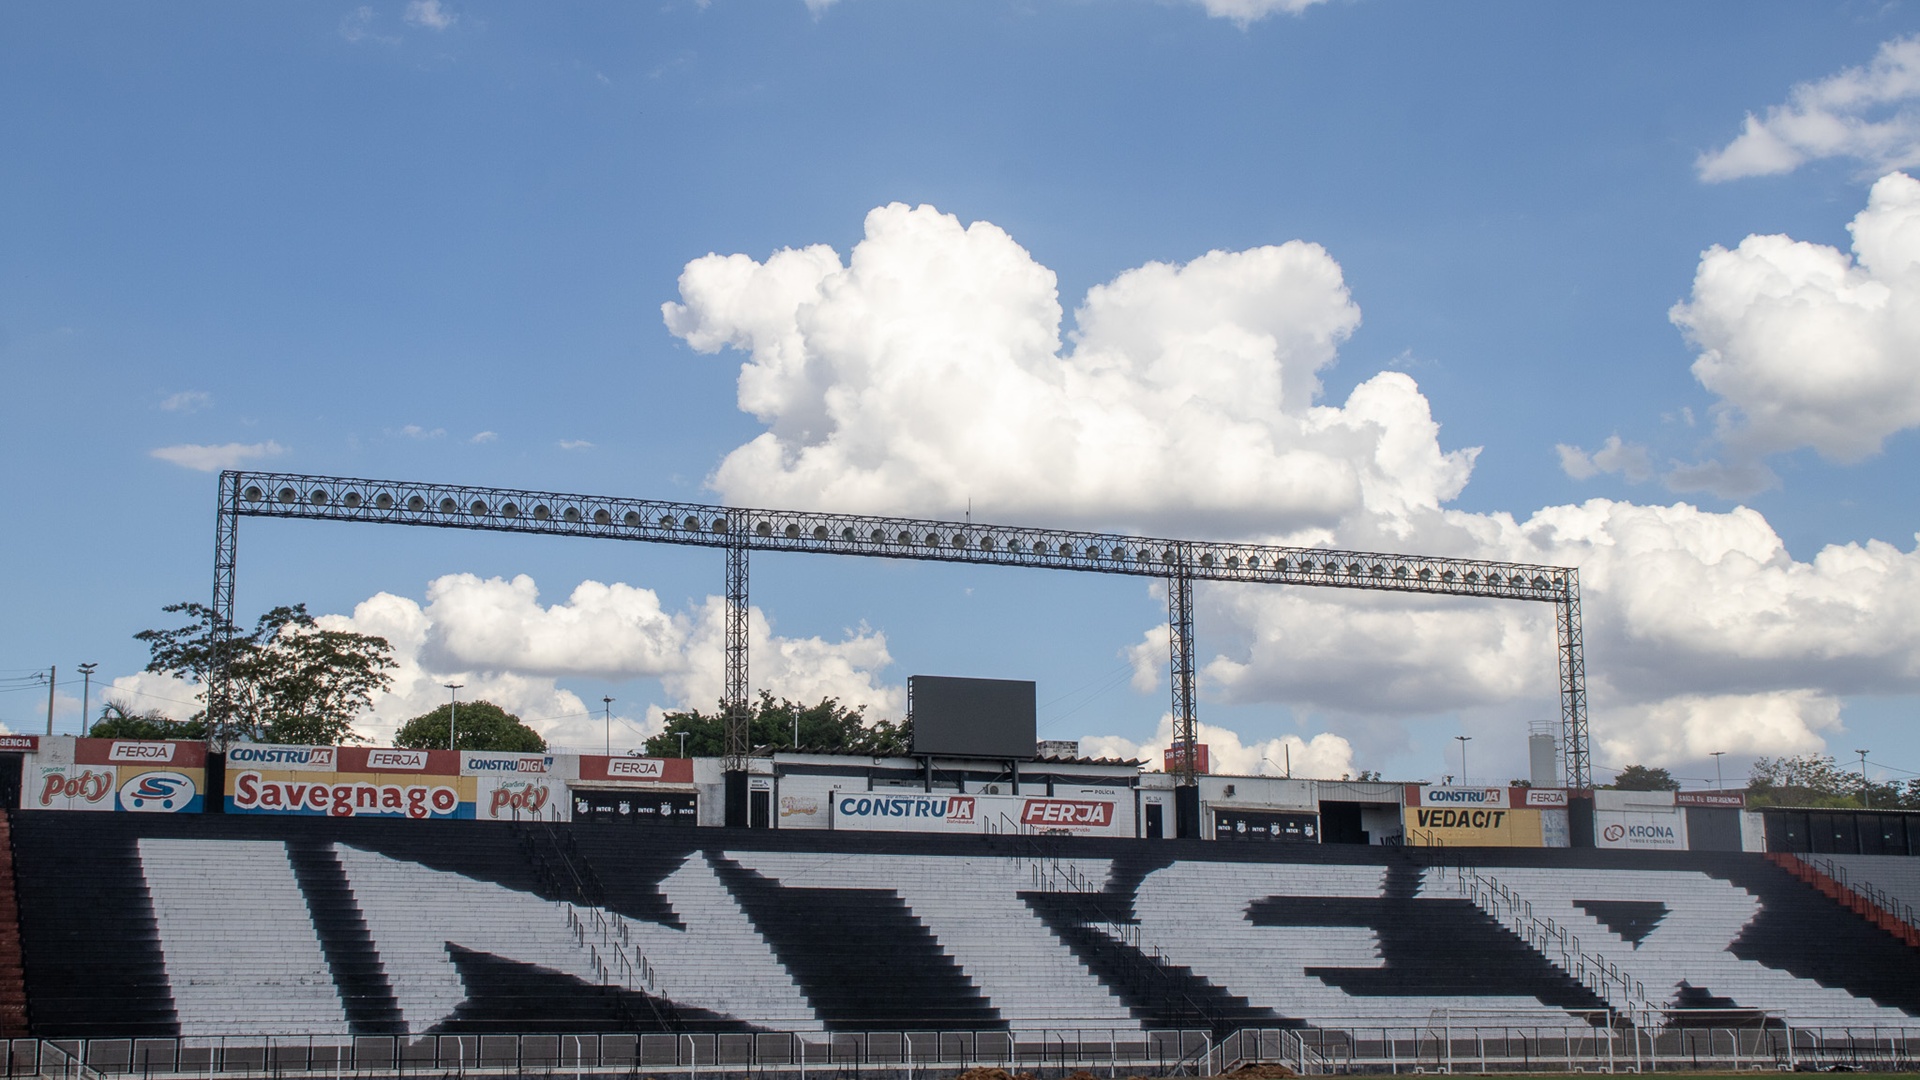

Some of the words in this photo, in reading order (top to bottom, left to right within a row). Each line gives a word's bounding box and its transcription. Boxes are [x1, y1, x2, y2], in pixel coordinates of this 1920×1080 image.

[116, 745, 168, 758] FERJÁ
[230, 748, 333, 763] CONSTRUJÁ
[373, 752, 421, 766] FERJÁ
[613, 761, 658, 774] FERJÁ
[236, 773, 457, 818] Savegnago
[1429, 789, 1500, 802] CONSTRUJÁ
[1531, 791, 1564, 802] FERJÁ
[840, 797, 976, 819] CONSTRUJÁ
[1026, 803, 1105, 823] FERJÁ
[1417, 809, 1505, 828] VEDACIT
[1629, 825, 1674, 838] KRONA
[138, 838, 1919, 1047] INTER
